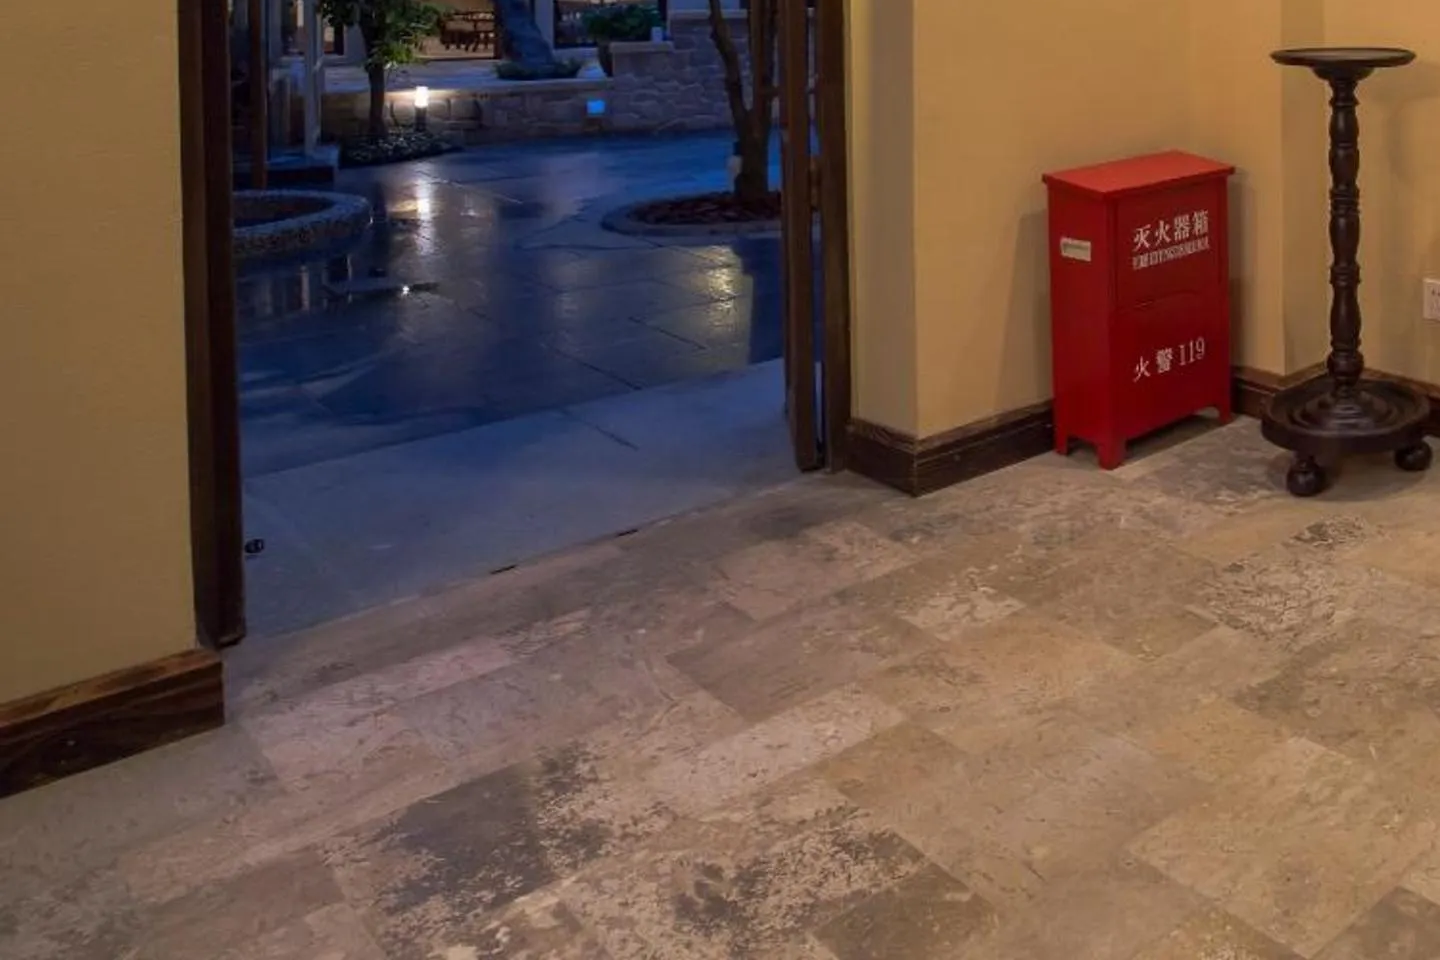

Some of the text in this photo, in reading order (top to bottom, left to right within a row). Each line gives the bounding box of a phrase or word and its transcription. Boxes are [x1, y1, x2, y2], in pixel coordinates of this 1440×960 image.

[1133, 210, 1209, 251] 灭火器箱
[1179, 336, 1205, 366] 119
